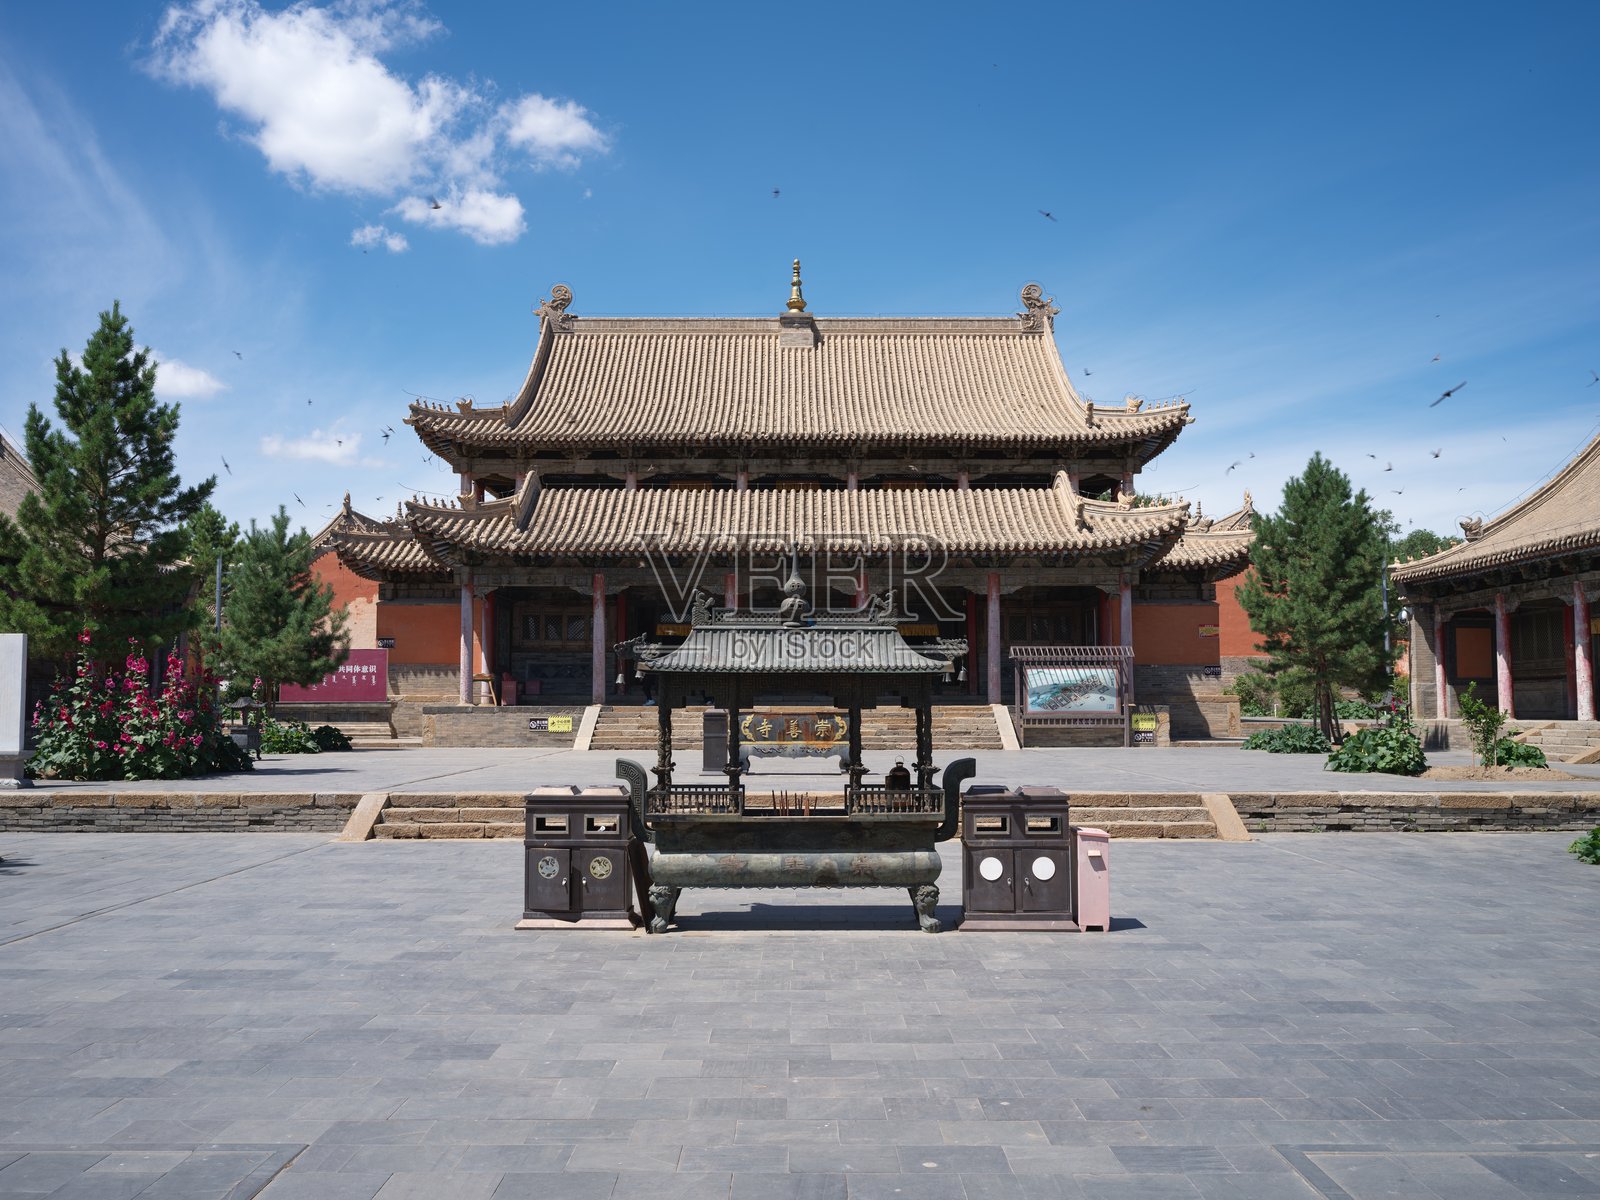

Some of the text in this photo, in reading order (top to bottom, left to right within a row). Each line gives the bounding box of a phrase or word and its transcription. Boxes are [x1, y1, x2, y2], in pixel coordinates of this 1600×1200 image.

[338, 665, 377, 673] 共同体意识
